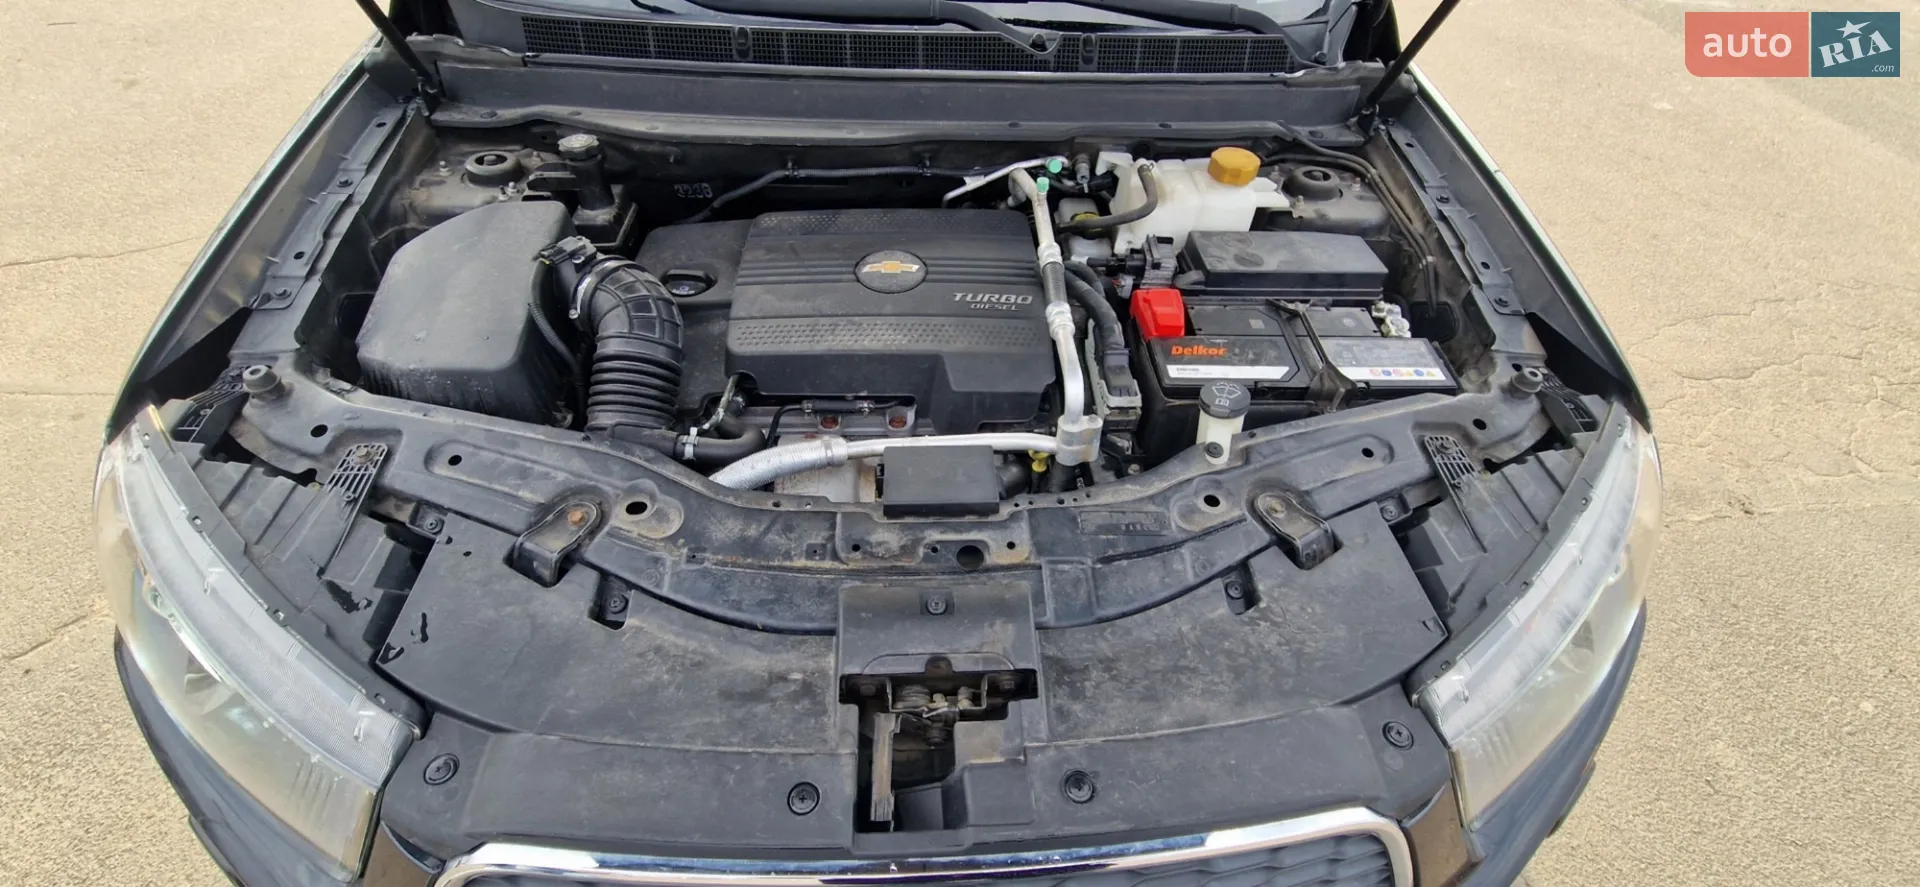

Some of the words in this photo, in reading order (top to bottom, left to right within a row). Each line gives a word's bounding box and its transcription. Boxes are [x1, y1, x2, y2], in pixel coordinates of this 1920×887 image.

[953, 292, 1033, 304] TURBO
[970, 303, 1019, 311] DIESEL
[1171, 344, 1227, 355] Delkor
